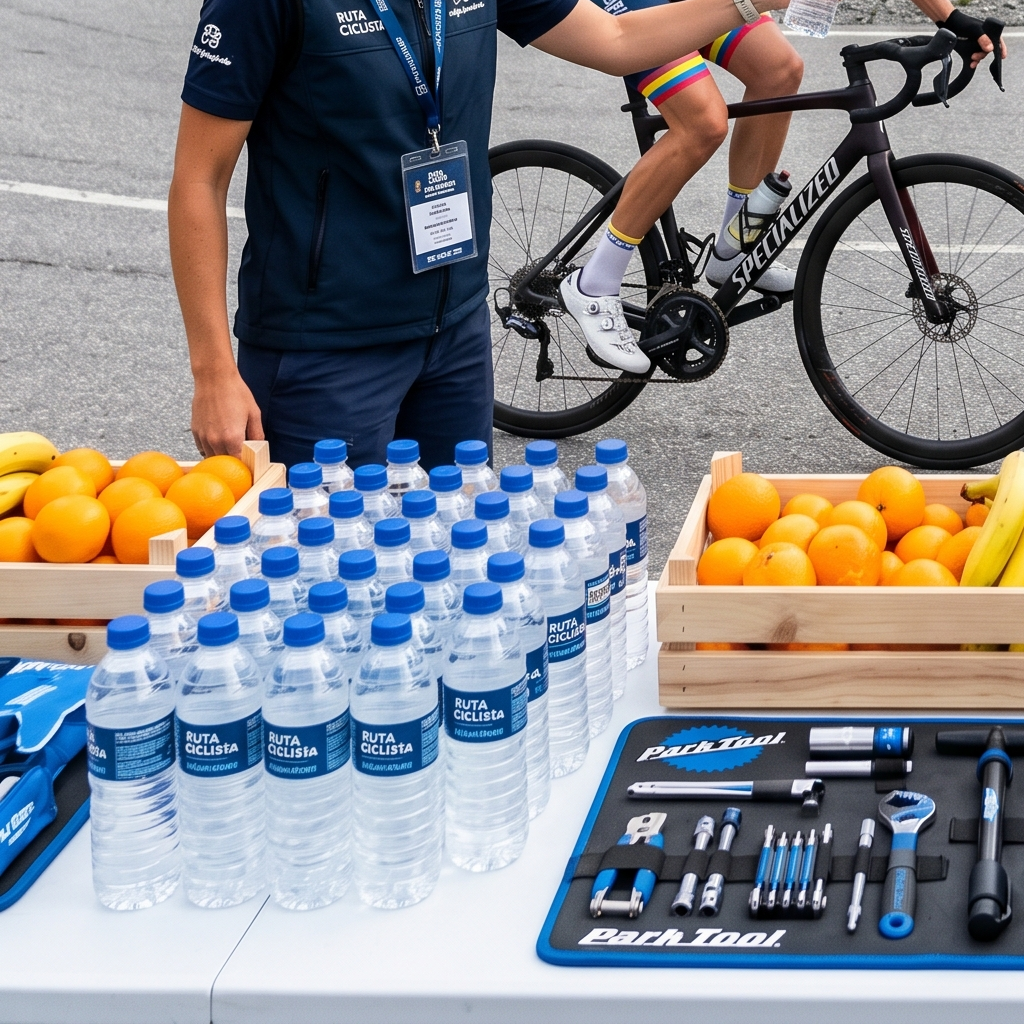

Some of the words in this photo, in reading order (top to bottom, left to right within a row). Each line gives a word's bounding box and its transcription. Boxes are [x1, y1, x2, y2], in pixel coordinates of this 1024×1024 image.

[336, 9, 367, 24] RUTA
[731, 156, 840, 295] SPECIALIZED
[549, 617, 578, 633] RUTA
[455, 697, 488, 711] RUTA
[186, 730, 220, 744] RUTA
[268, 731, 301, 747] RUTA
[362, 730, 396, 744] RUTA
[636, 741, 713, 763] Park
